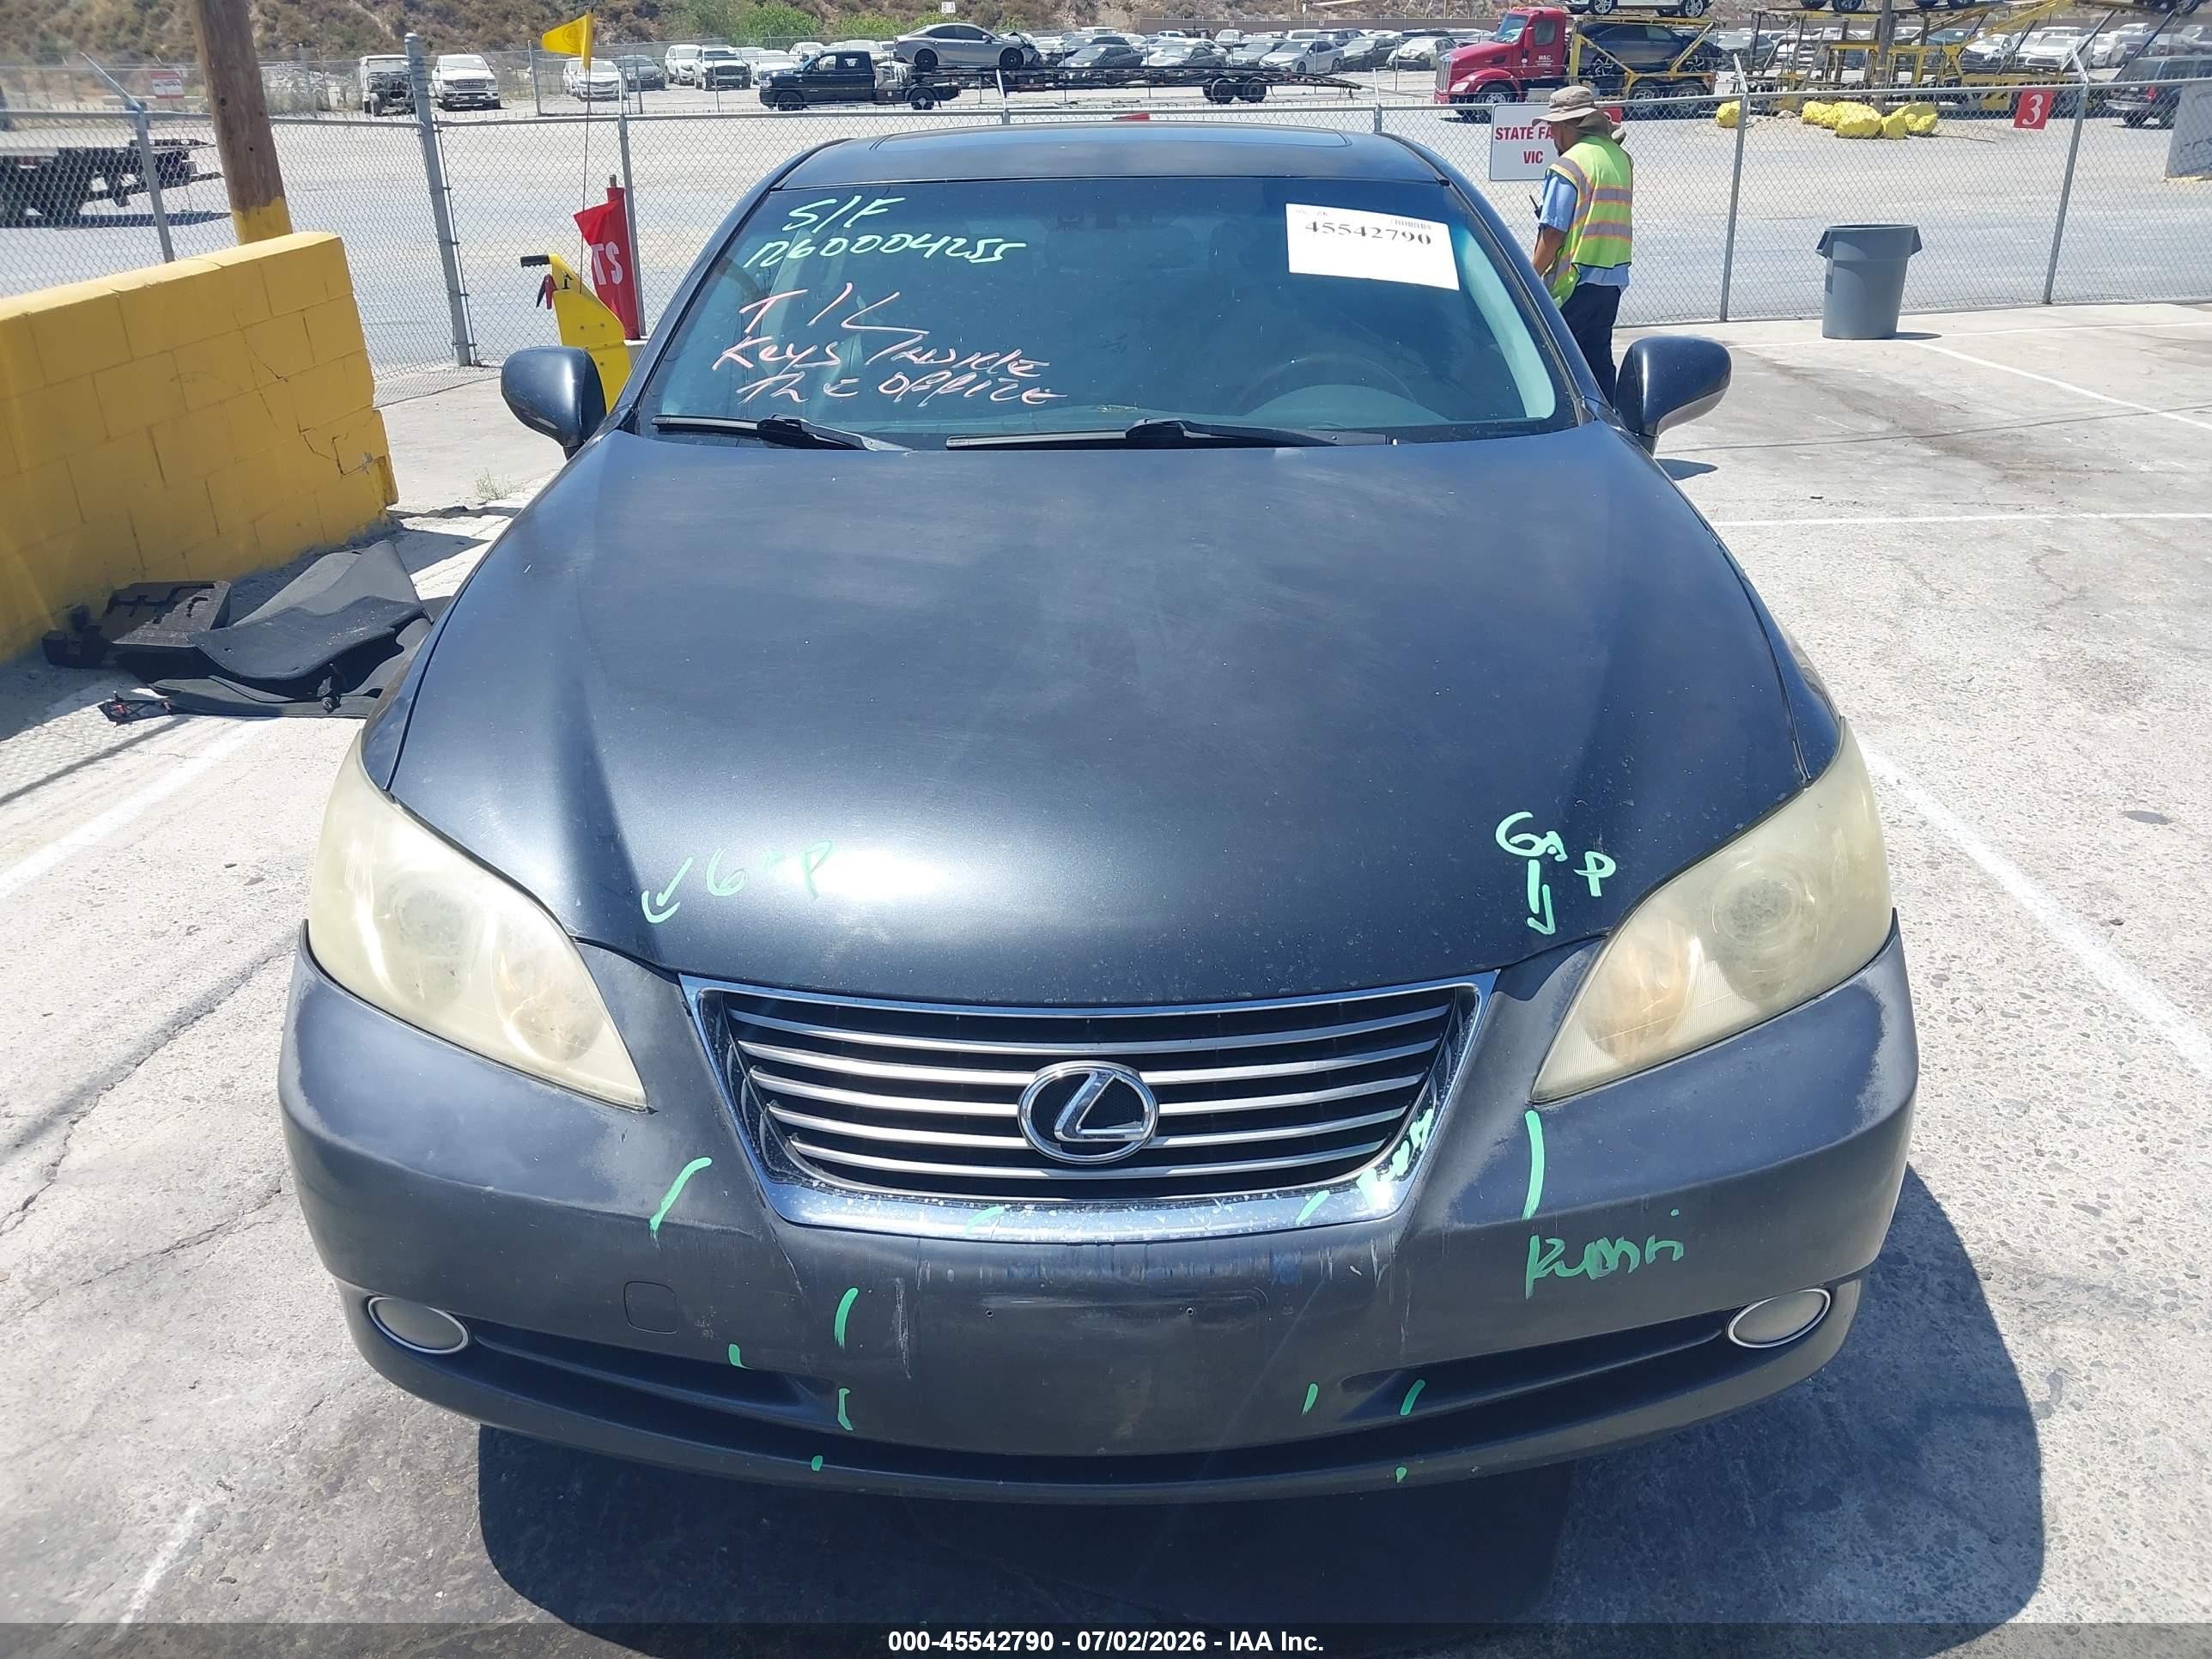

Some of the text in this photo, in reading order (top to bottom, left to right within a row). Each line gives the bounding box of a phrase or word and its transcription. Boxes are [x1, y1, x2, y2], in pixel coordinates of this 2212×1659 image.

[2021, 94, 2044, 125] 3
[1495, 126, 1534, 140] STATE
[1523, 150, 1544, 164] VIC
[1304, 221, 1431, 246] 45542790
